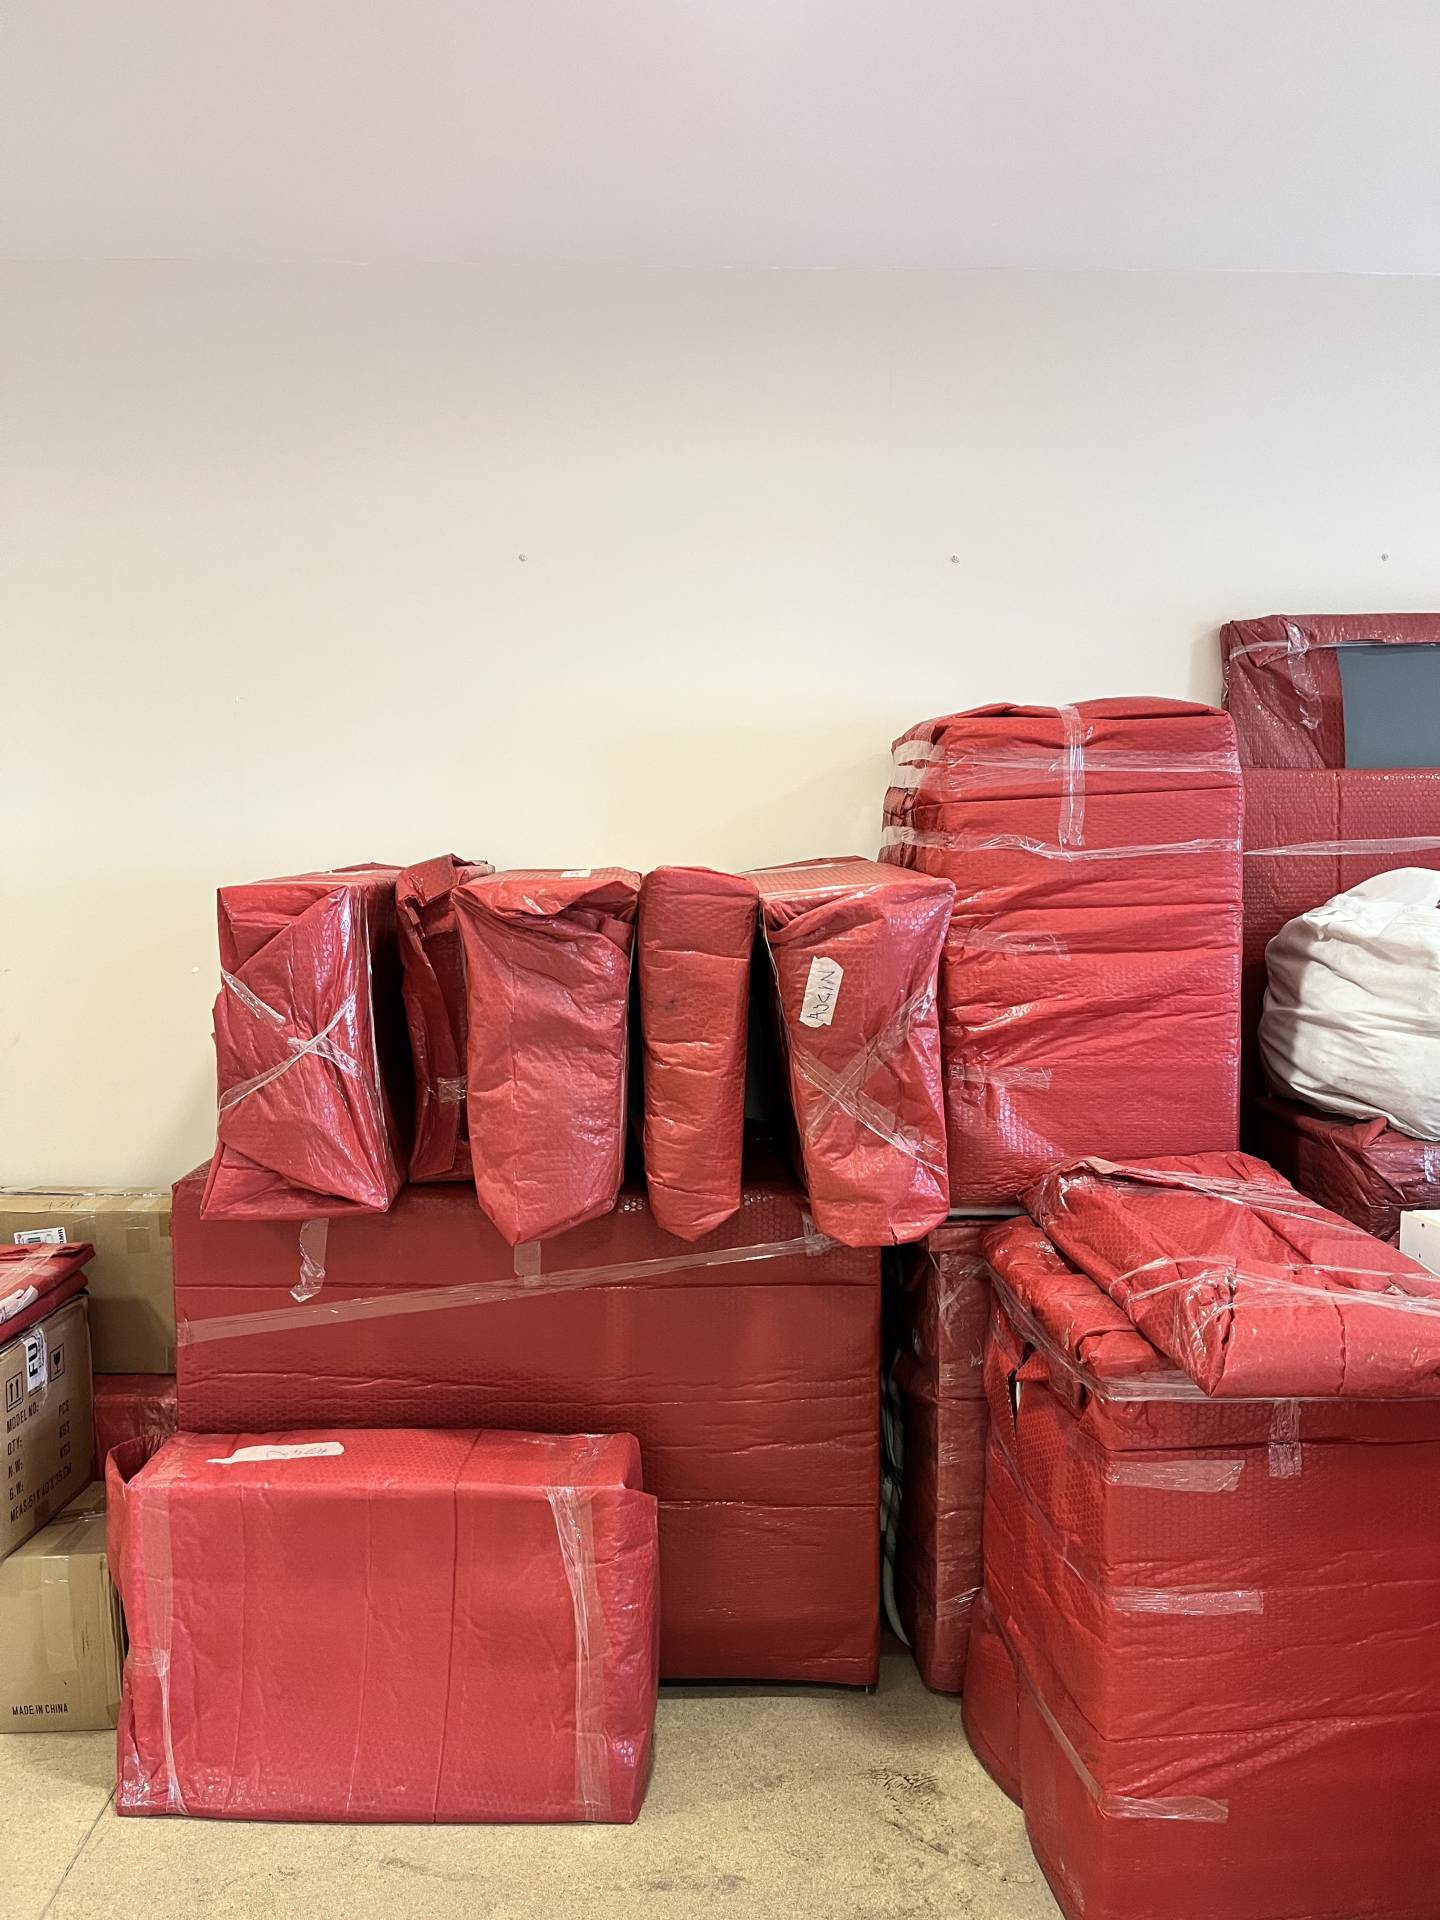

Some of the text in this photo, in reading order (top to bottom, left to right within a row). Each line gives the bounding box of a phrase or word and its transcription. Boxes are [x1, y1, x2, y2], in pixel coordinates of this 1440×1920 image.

[7, 1402, 39, 1433] MODEL NO:
[12, 1703, 69, 1715] MADE IN CHINA
